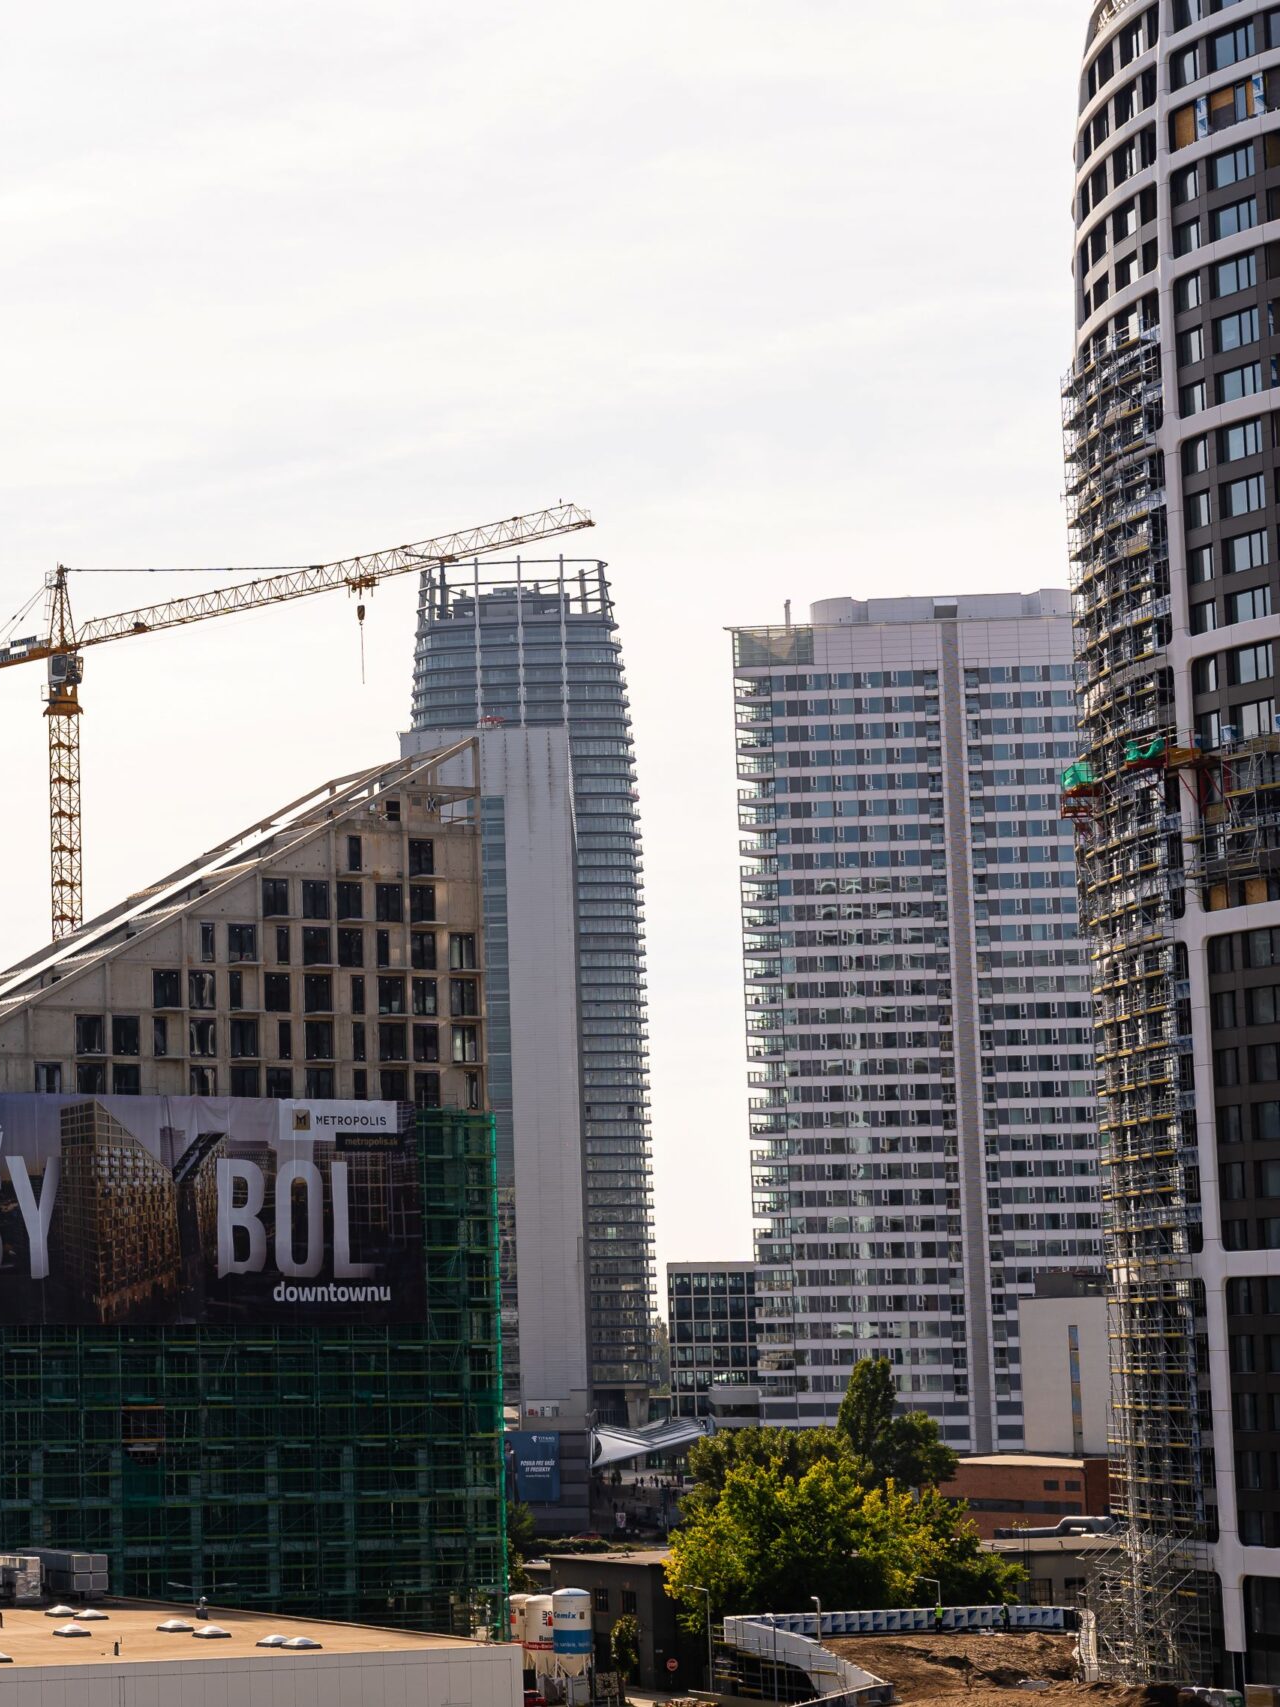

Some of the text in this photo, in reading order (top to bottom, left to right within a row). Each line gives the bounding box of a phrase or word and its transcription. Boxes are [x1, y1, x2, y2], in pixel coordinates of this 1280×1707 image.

[316, 1115, 387, 1126] METROPOLIS
[273, 1281, 392, 1303] downtownu
[553, 1611, 576, 1619] Cemix
